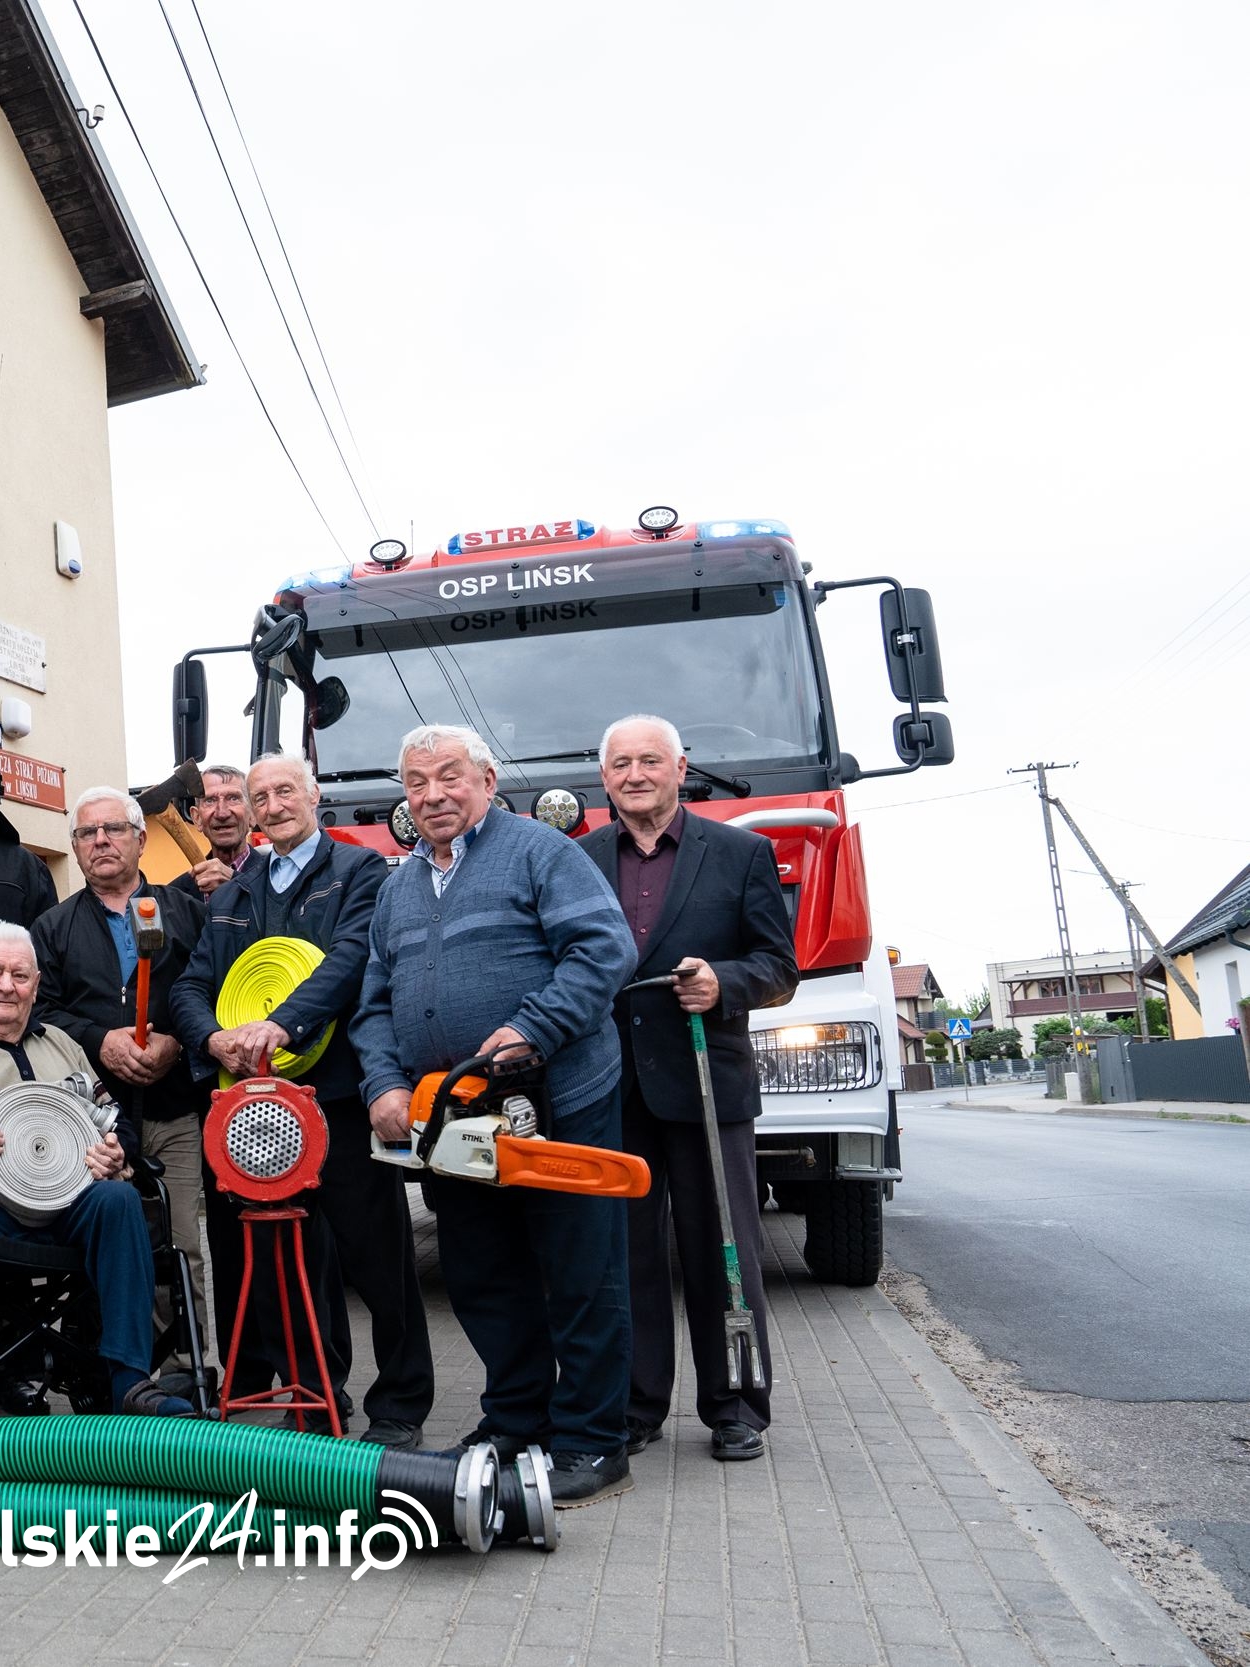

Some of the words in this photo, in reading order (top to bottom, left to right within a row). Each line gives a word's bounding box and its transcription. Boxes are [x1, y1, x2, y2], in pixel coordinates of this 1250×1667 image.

[464, 521, 574, 547] STRAŻ
[439, 575, 498, 599] OSP
[507, 563, 595, 591] LIŃSK
[15, 760, 34, 780] STRAŻ
[36, 765, 61, 788] POŻARNA
[15, 778, 38, 800] LIŃSKU
[462, 1133, 485, 1143] STIHL
